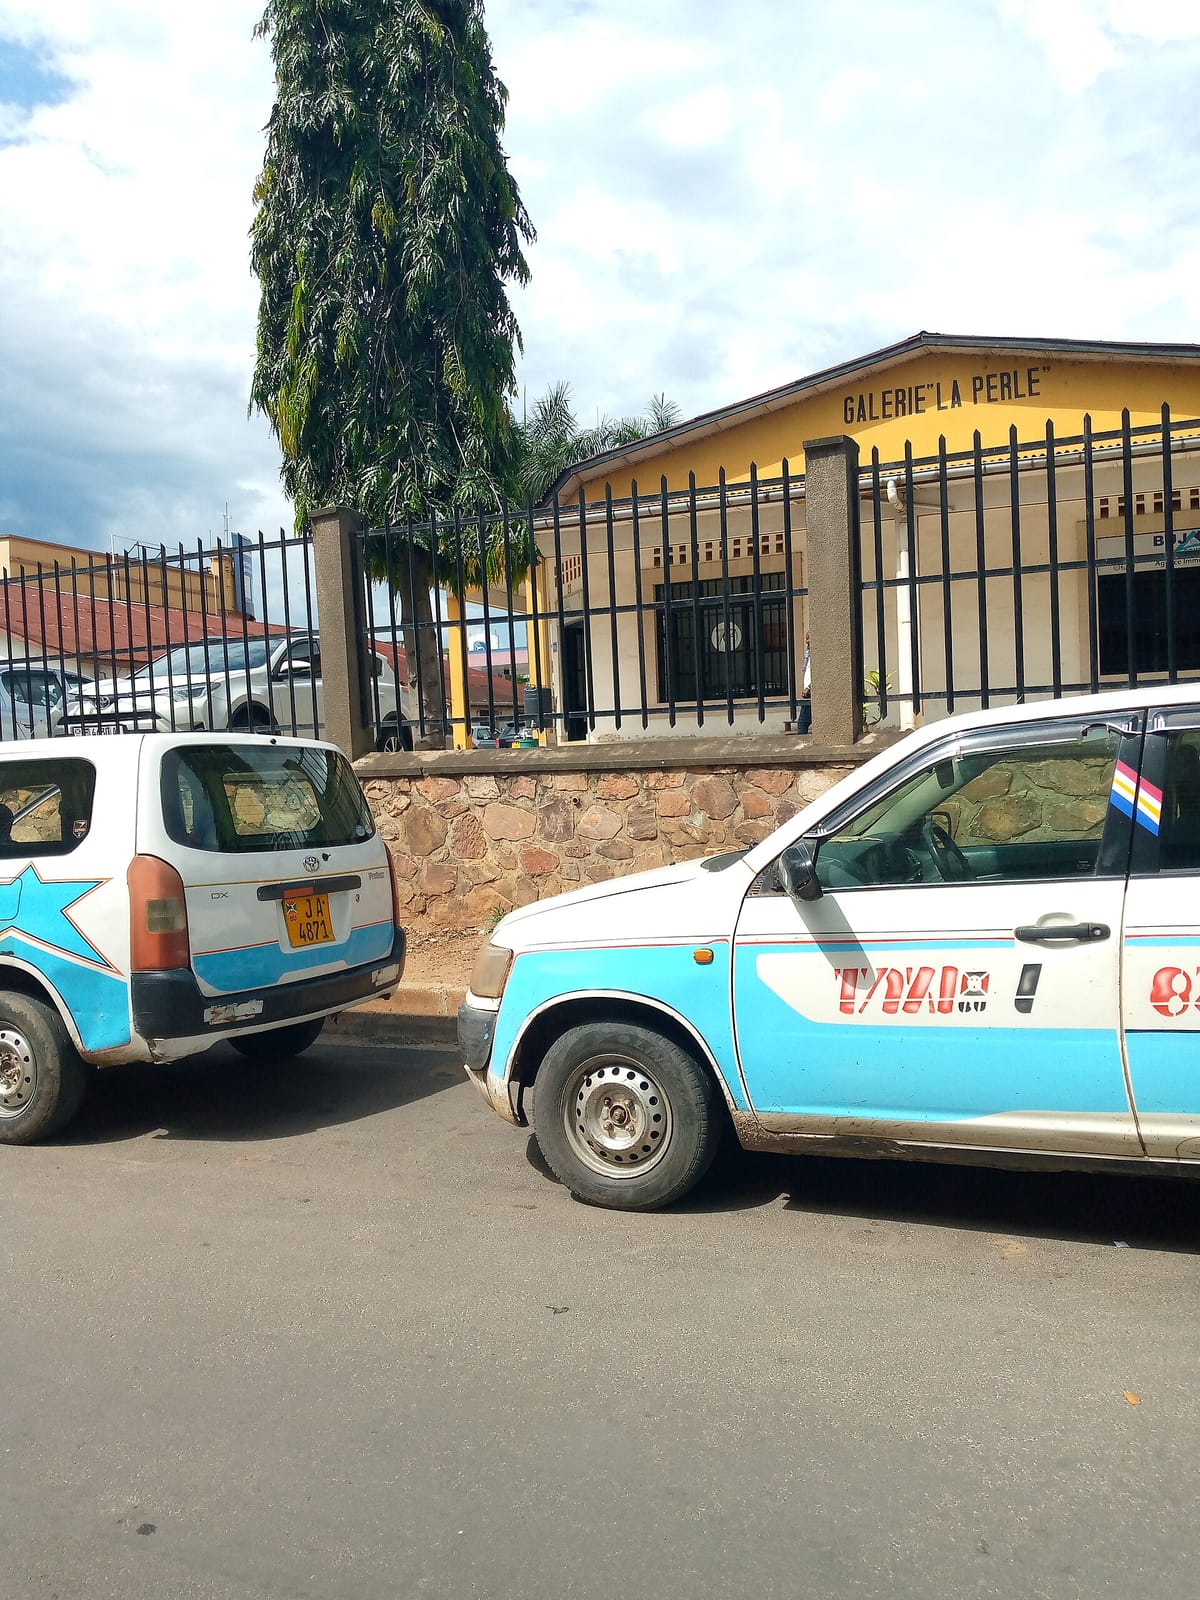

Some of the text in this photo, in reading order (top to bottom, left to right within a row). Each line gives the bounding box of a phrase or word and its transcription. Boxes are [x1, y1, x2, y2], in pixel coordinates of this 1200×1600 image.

[843, 384, 926, 424] GALERIE
[210, 892, 229, 900] DX
[299, 920, 330, 942] 4871
[834, 965, 959, 1014] TAXI
[1150, 966, 1200, 1017] 8
